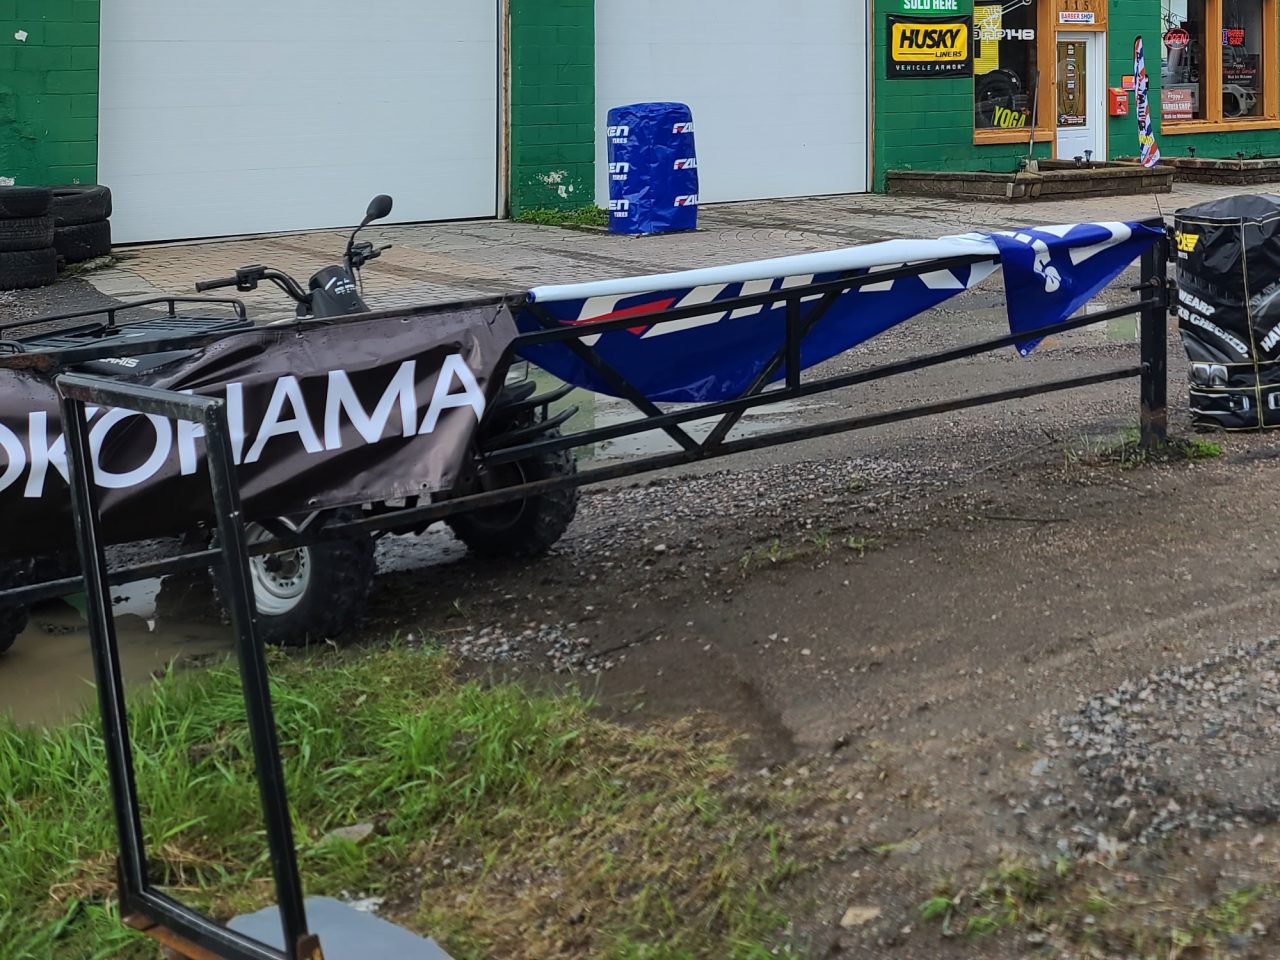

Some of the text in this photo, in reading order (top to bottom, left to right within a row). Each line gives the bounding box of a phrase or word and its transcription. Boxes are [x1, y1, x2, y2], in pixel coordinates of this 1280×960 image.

[899, 29, 961, 49] HUSKY
[1165, 33, 1187, 45] OPEN
[993, 105, 1026, 129] YOGA
